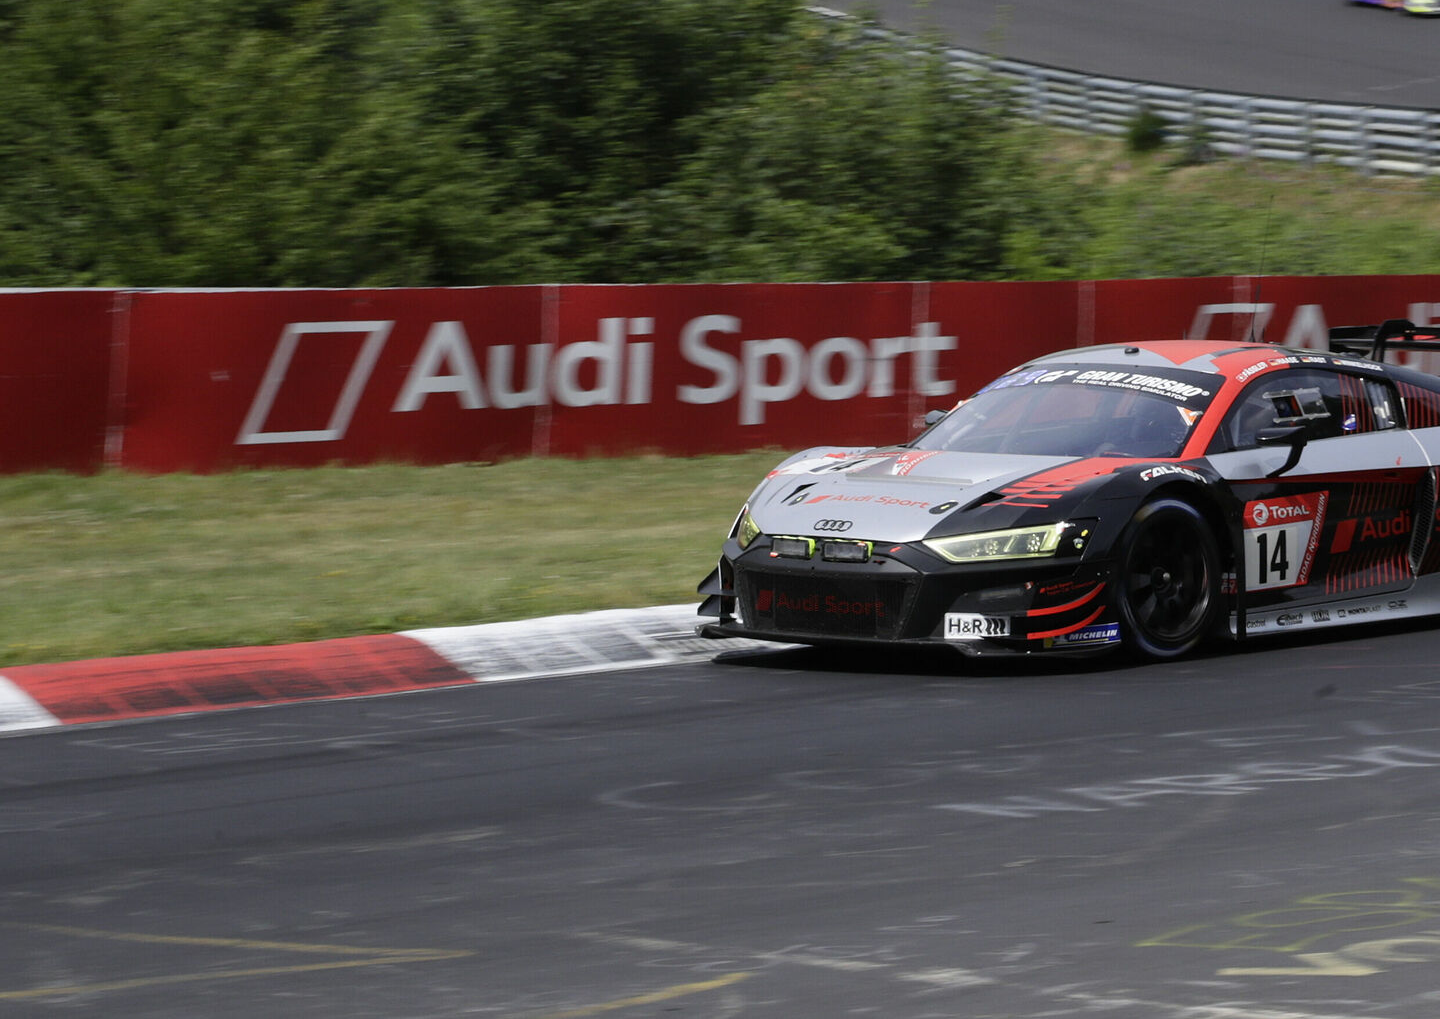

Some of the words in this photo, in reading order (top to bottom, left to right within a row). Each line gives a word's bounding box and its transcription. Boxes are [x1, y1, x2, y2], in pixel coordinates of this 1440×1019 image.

[391, 315, 655, 413] Audi
[677, 314, 959, 426] Sport
[1072, 378, 1087, 386] THE
[1087, 379, 1108, 388] REAL
[1107, 381, 1142, 393] DRIVING
[1140, 386, 1189, 402] SIMULATOR
[1076, 369, 1124, 384] GRAN
[1123, 373, 1203, 397] TURISMO
[1140, 465, 1208, 484] FALKEN
[832, 494, 873, 502] Audi
[875, 495, 931, 510] Sport
[1269, 505, 1310, 519] TOTAL
[1309, 493, 1326, 553] NORDRHEIN
[1360, 508, 1411, 542] Audi
[1257, 529, 1289, 584] 14
[777, 593, 820, 612] Audi
[825, 594, 886, 617] Sport
[949, 617, 983, 635] H&R
[1068, 629, 1118, 641] MICHELIN
